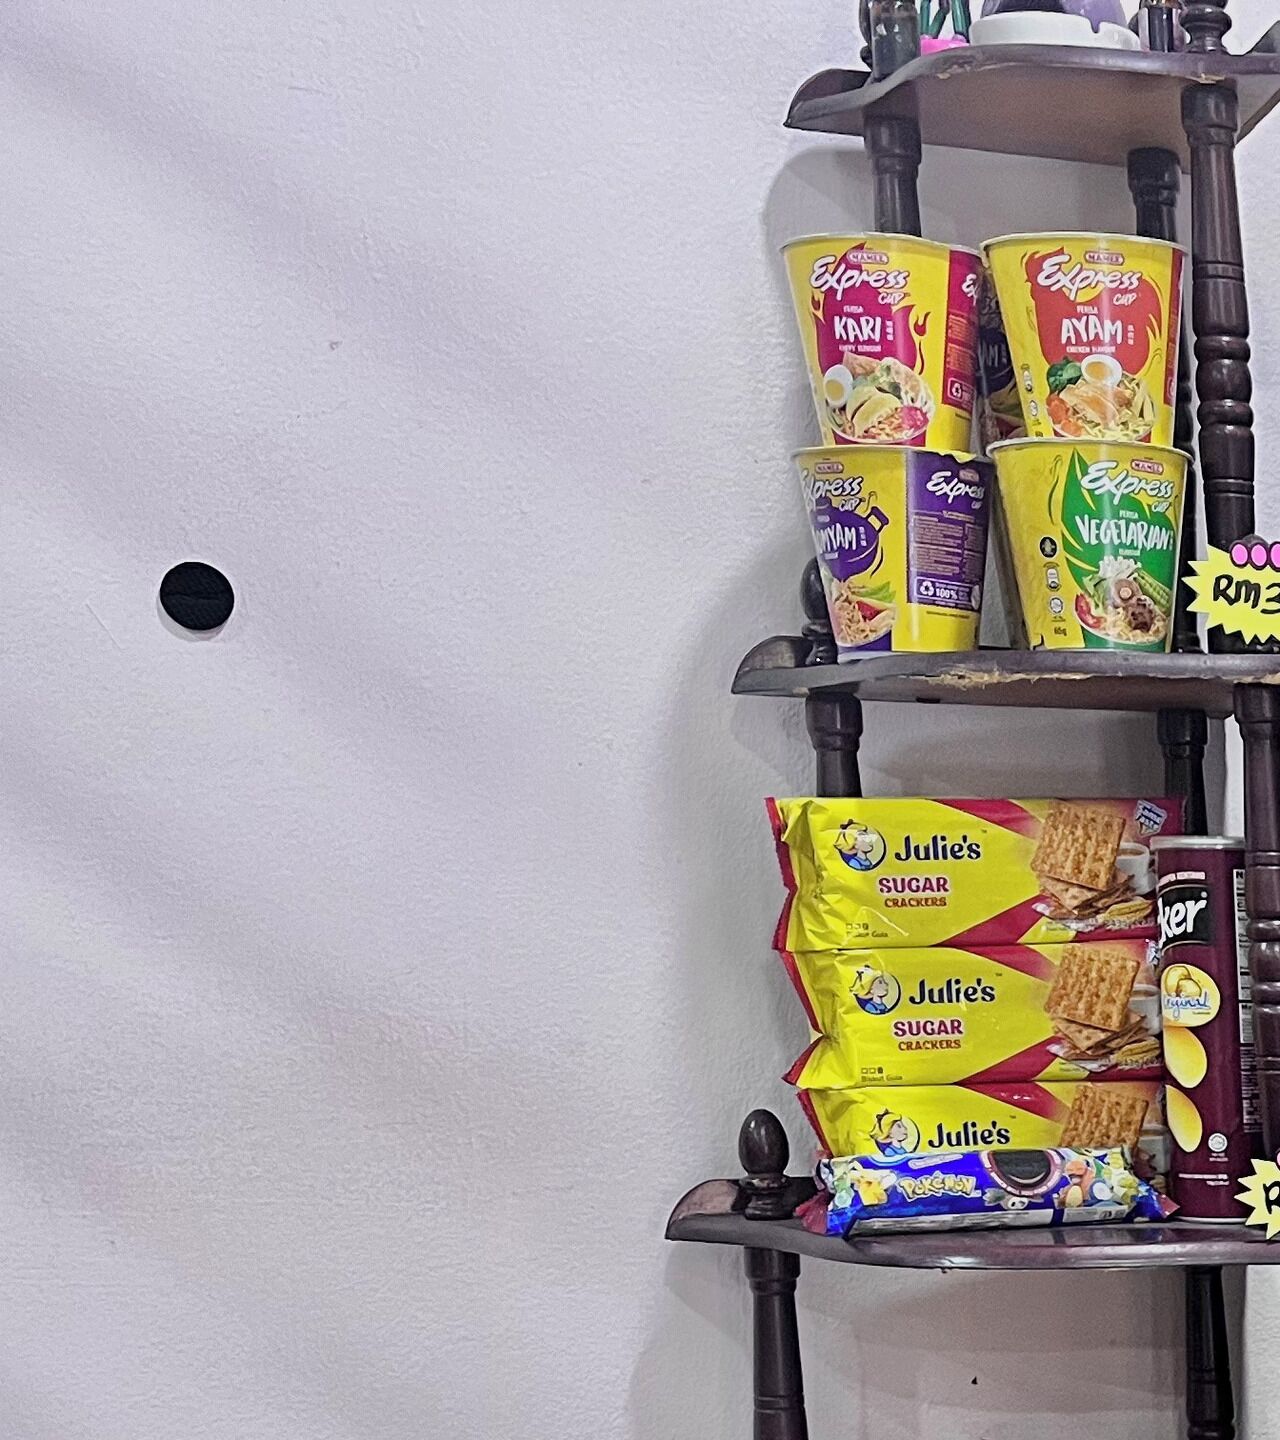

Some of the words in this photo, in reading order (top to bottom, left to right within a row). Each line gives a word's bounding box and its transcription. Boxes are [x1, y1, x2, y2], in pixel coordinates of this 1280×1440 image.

[810, 255, 910, 300] Express
[1037, 254, 1142, 300] Express
[878, 292, 905, 304] CUP
[1113, 293, 1137, 305] CUP
[833, 315, 881, 342] KARI
[1061, 315, 1122, 344] AYAM
[926, 471, 985, 503] Express
[1081, 461, 1175, 505] Express
[1074, 514, 1168, 551] VEGETARIAN
[894, 835, 981, 861] Julie's
[879, 877, 949, 893] SUGAR
[884, 897, 947, 908] CRACKERS
[1158, 897, 1207, 947] ker
[908, 978, 995, 1005] Julie's
[893, 1019, 963, 1037] SUGAR
[898, 1039, 961, 1051] CRACKERS
[928, 1121, 1010, 1148] Julie's
